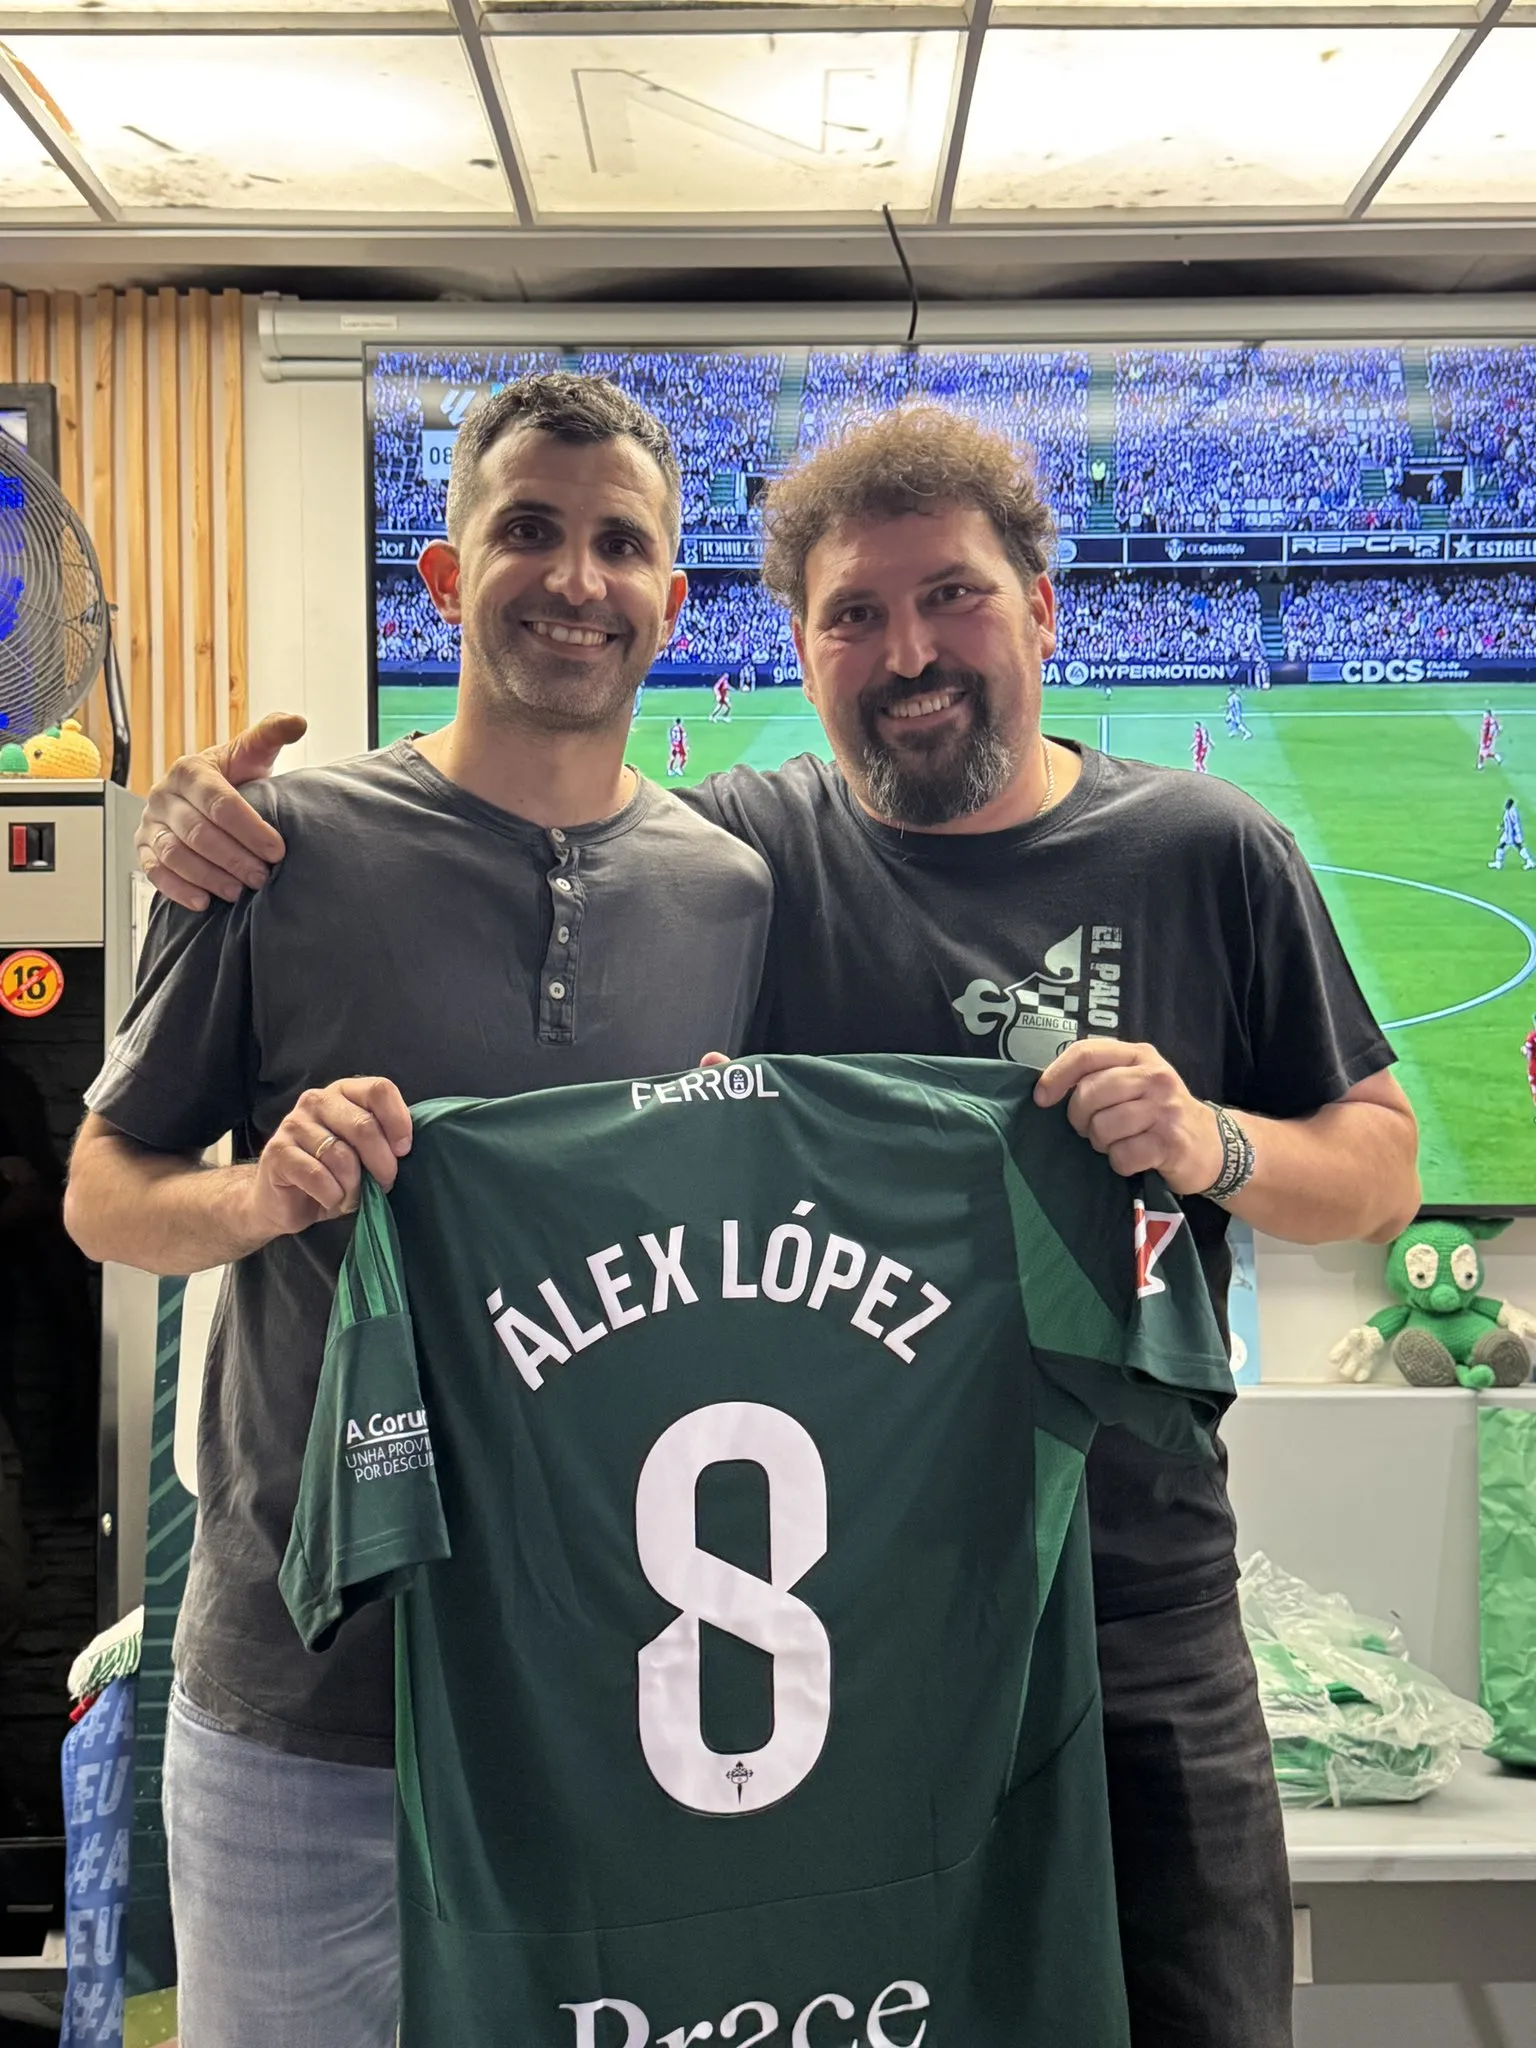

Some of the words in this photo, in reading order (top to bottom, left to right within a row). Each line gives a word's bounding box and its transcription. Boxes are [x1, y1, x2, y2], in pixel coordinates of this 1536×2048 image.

[1292, 536, 1441, 554] REPCAR
[1341, 659, 1425, 682] CDCS
[1091, 925, 1122, 954] EL
[13, 966, 46, 1001] 18
[1088, 962, 1121, 1029] PALO
[1022, 1014, 1060, 1029] RACING
[631, 1064, 780, 1111] FERROL
[486, 1225, 699, 1391] ÁLEX
[722, 1199, 952, 1364] LÓPEZ
[346, 1418, 365, 1445] A
[345, 1446, 386, 1469] UNHA
[354, 1463, 382, 1484] POR
[635, 1401, 832, 1815] 8
